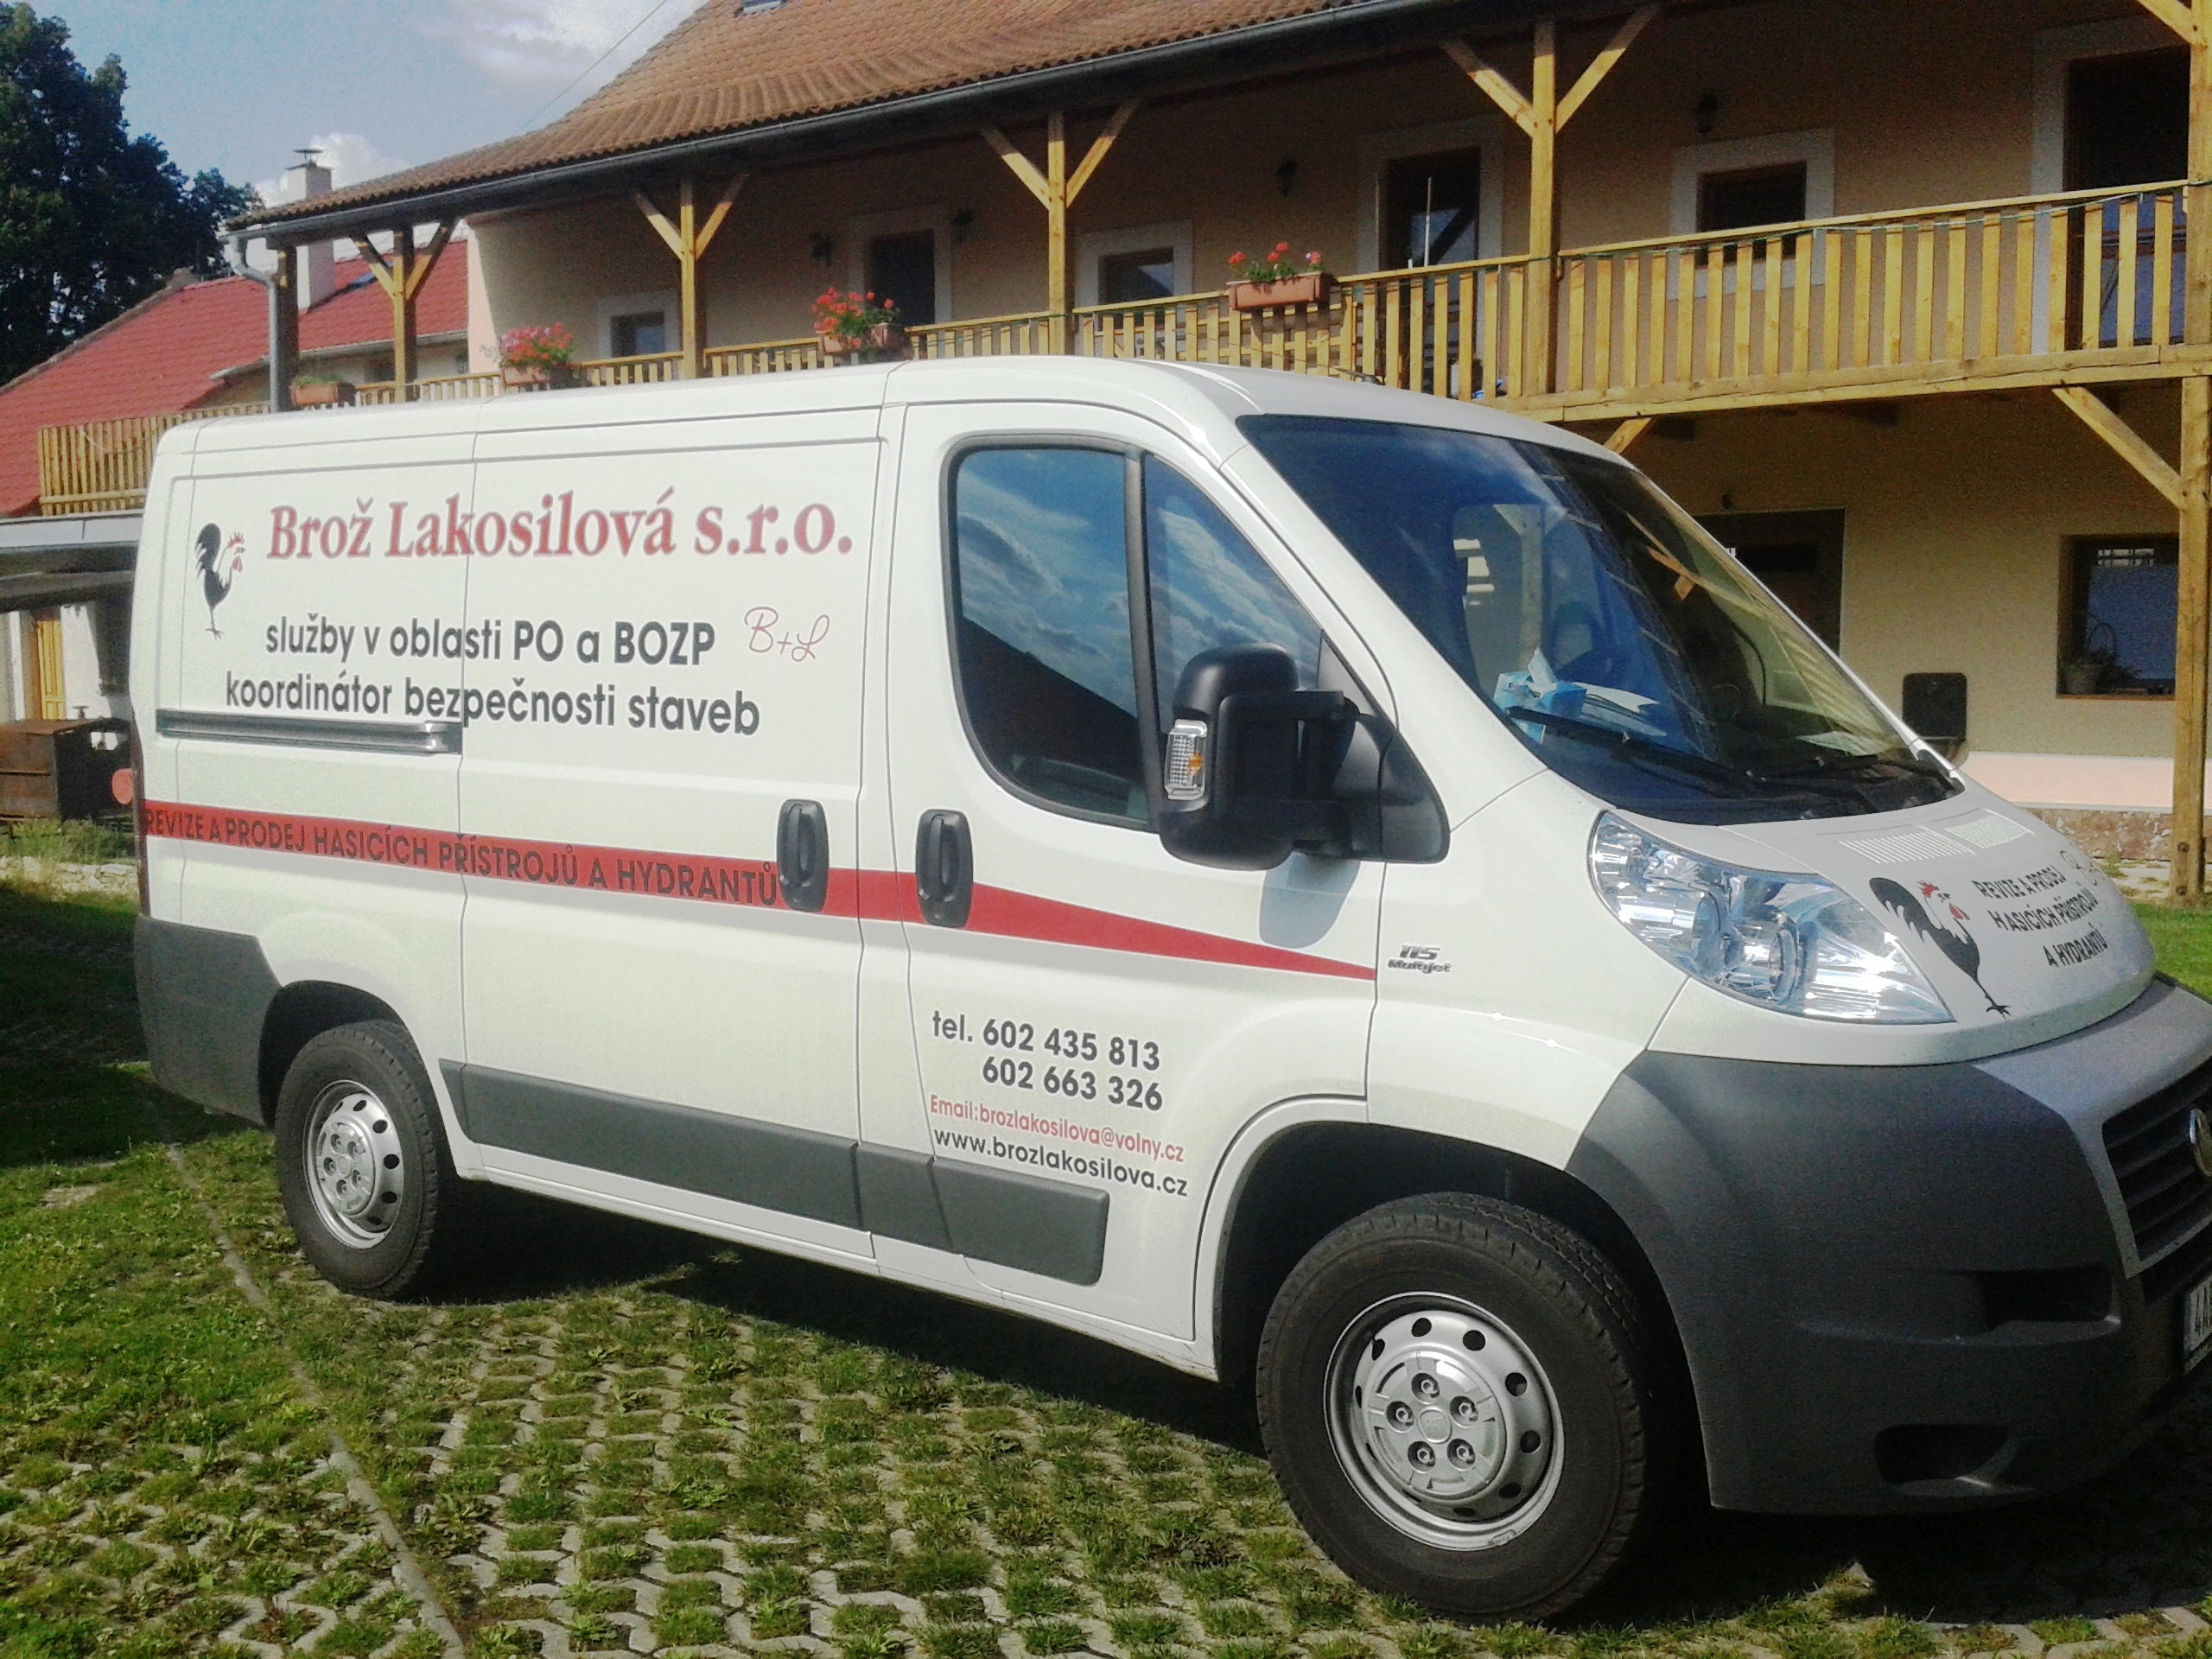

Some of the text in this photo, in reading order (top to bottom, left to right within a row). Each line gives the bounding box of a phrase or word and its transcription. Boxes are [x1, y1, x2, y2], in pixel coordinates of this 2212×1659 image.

[266, 486, 853, 559] Brož Lakosilová s.r.o.
[266, 613, 715, 665] služby v oblasti PO a BOZP
[226, 670, 760, 736] koordinátor bezpečnosti staveb
[143, 807, 777, 906] REVIZE A PRODEJ HASICÍCH PŘÍSTROJŮ A HYDRANTŮ
[2043, 945, 2060, 968] A
[932, 1010, 1160, 1071] tel. 602 435 813
[982, 1056, 1163, 1112] 602 663 326
[933, 1128, 1189, 1198] www.brozlakosilova.cz
